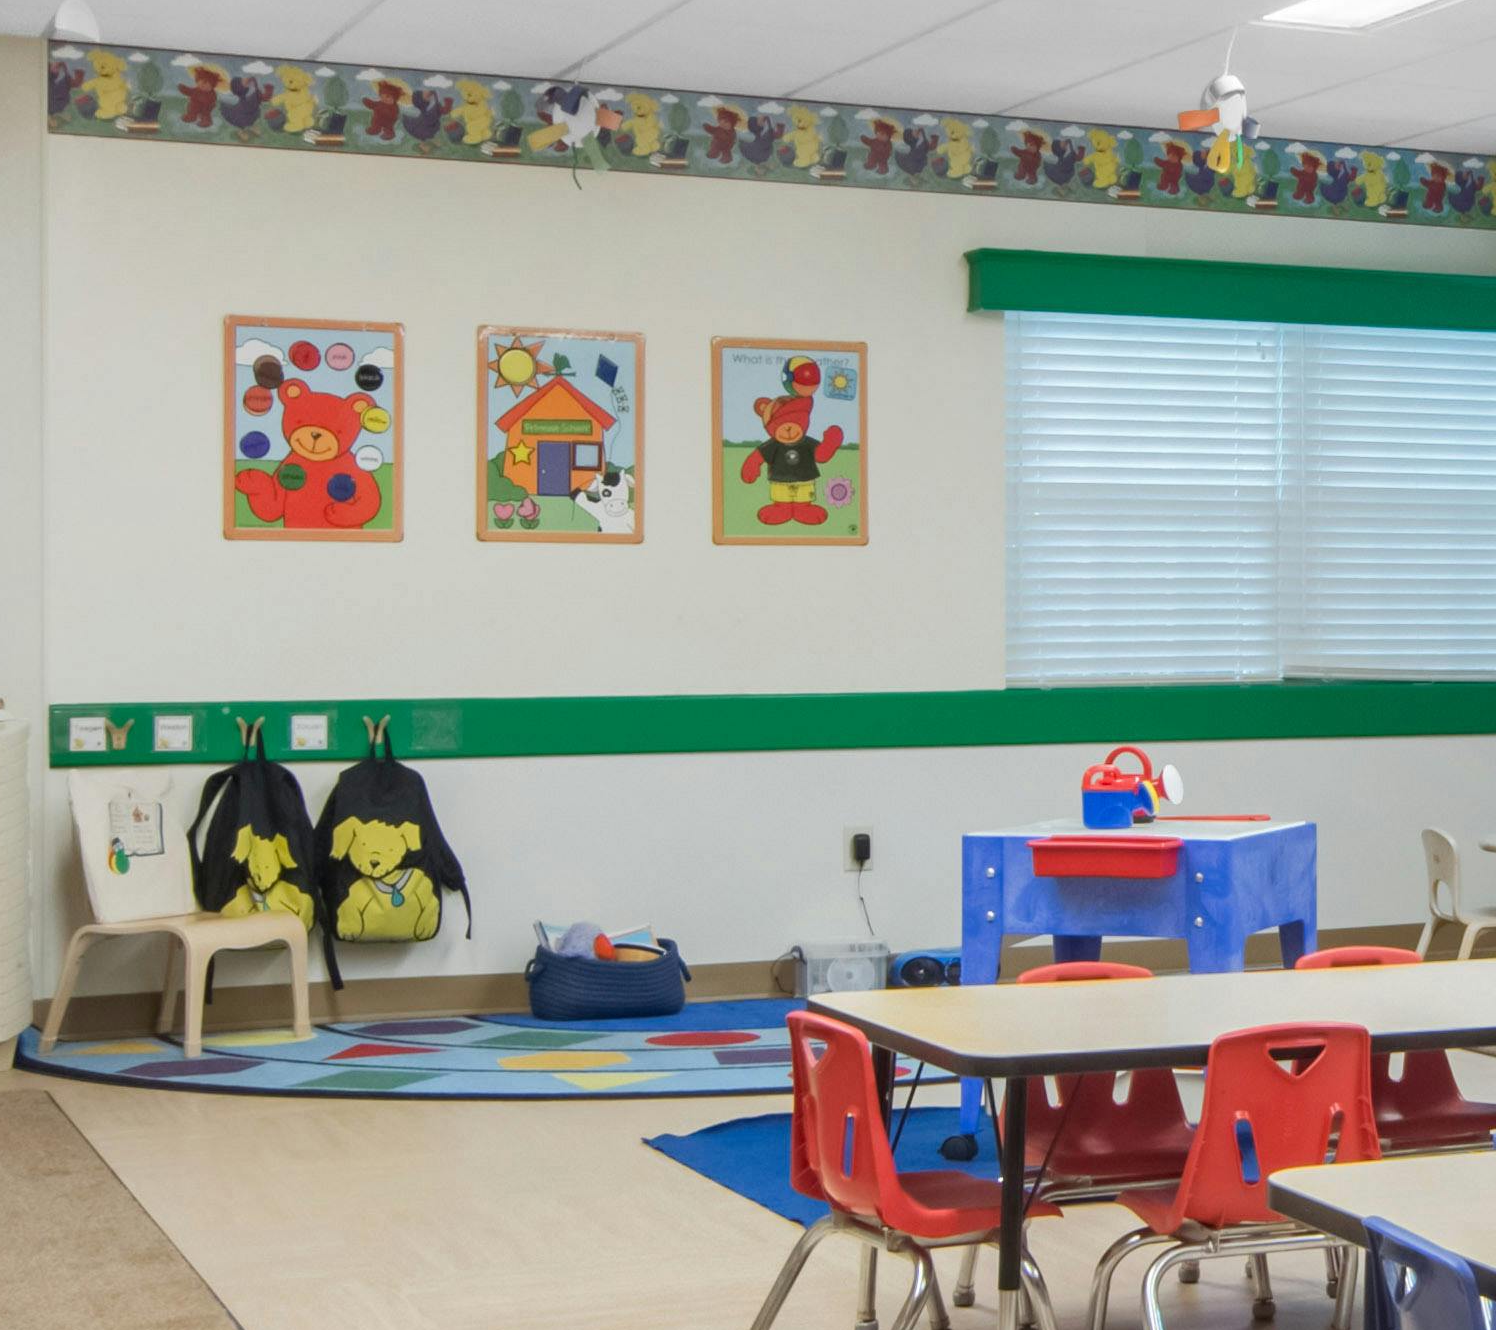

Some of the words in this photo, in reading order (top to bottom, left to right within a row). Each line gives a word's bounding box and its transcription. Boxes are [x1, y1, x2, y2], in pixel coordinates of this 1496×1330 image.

[732, 354, 762, 365] What
[765, 355, 774, 365] is
[818, 357, 850, 368] ather?
